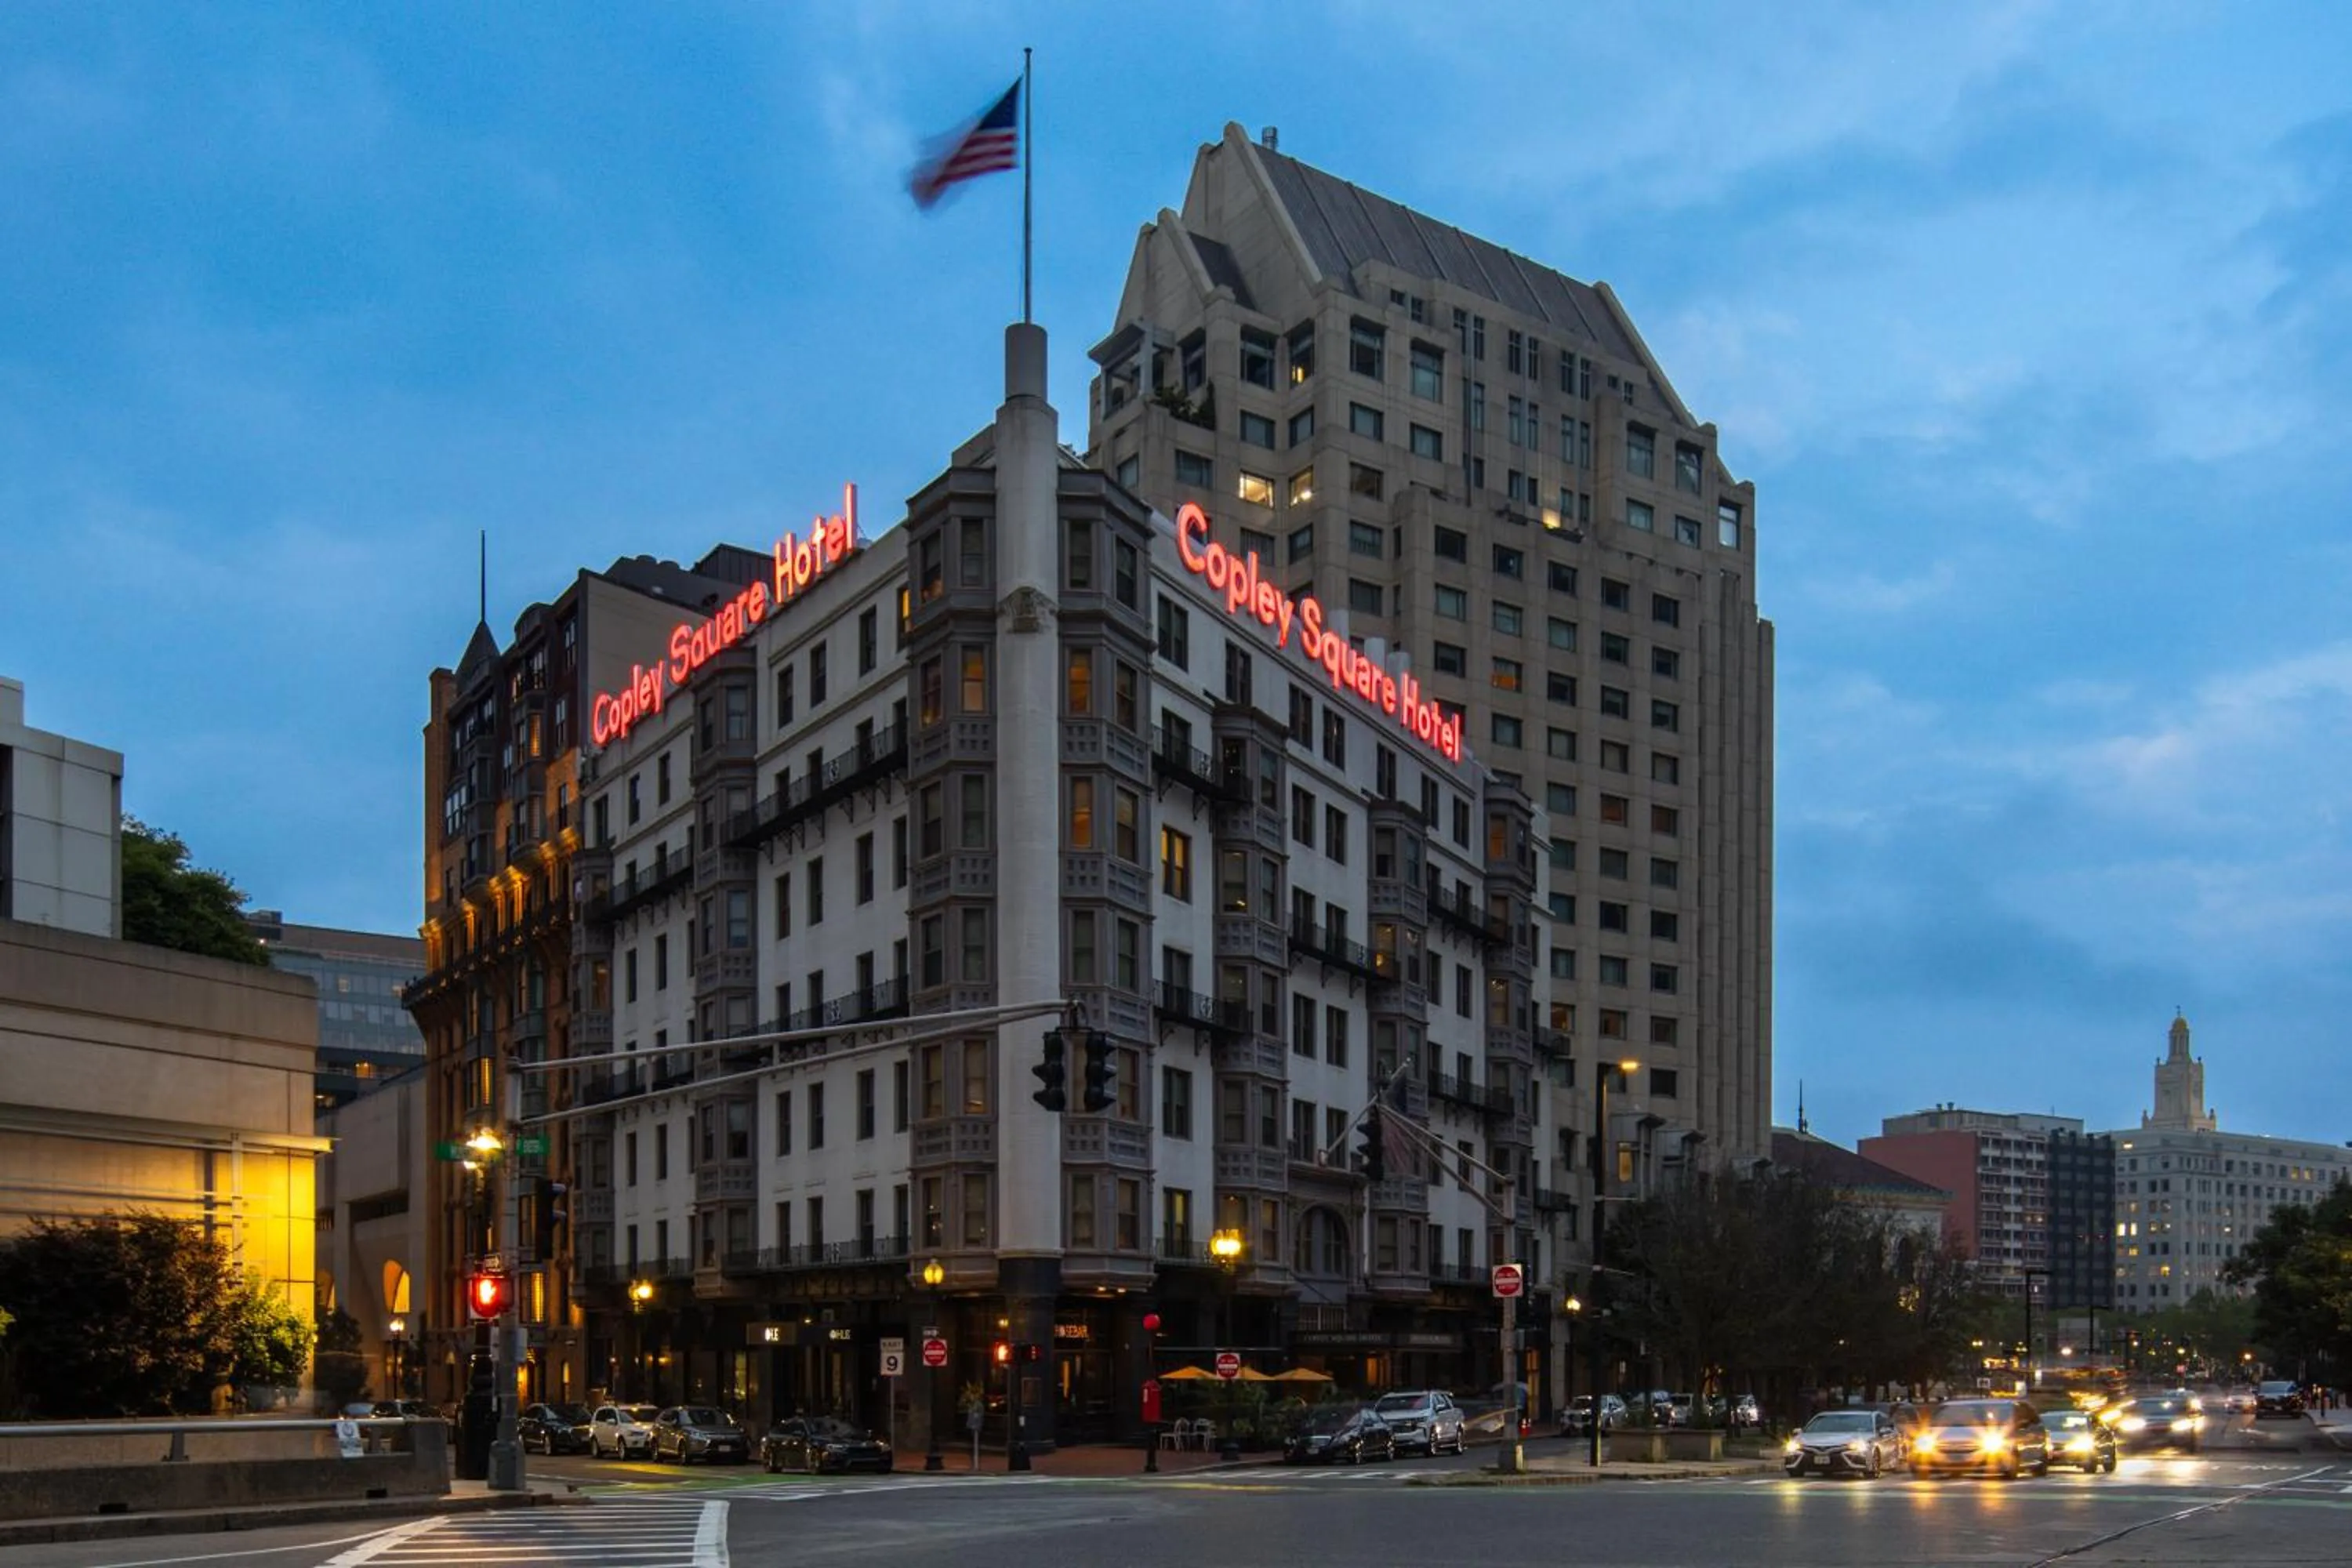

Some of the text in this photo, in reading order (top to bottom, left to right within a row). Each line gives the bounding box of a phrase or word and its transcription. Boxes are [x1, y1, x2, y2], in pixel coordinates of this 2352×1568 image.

[593, 659, 664, 746] Copley
[773, 481, 858, 605] Hotel
[1175, 502, 1461, 764] Copley Square Hotel
[887, 1356, 898, 1372] 9
